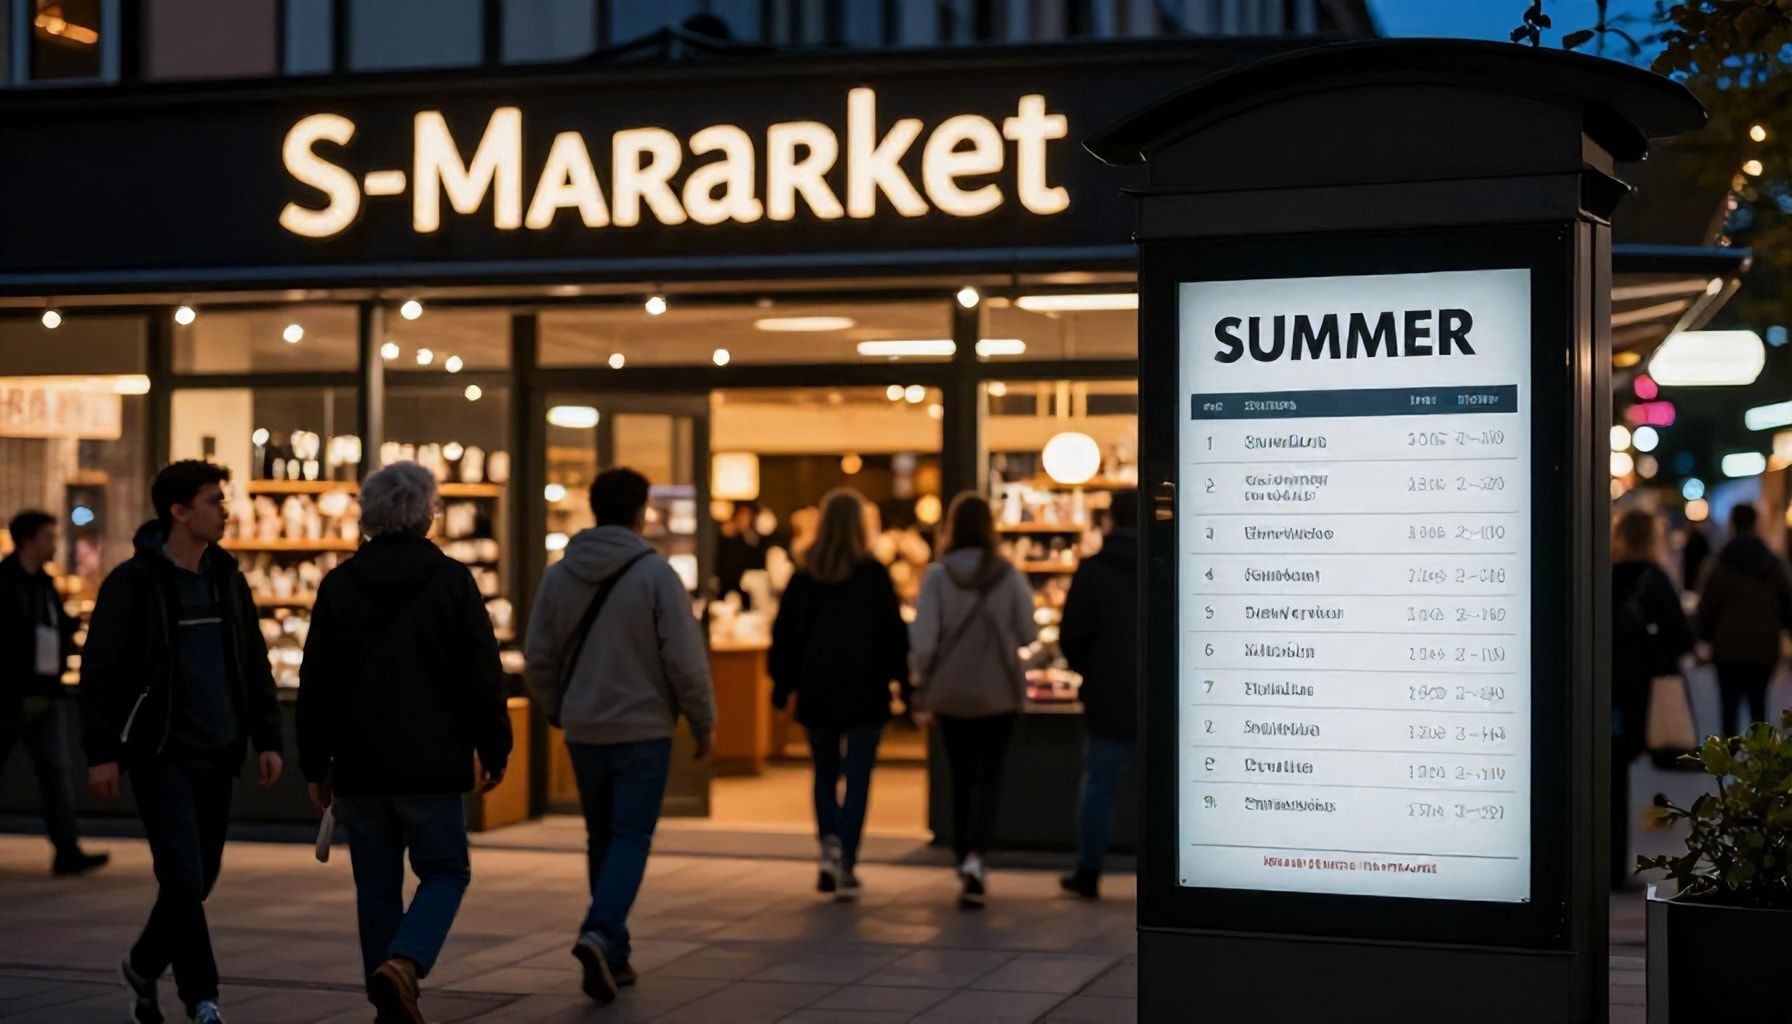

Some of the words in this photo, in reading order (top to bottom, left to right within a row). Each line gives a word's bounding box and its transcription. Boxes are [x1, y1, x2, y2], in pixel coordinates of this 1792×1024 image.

[1213, 308, 1477, 364] SUMMER
[1204, 643, 1215, 657] 6
[1203, 679, 1215, 694] 7
